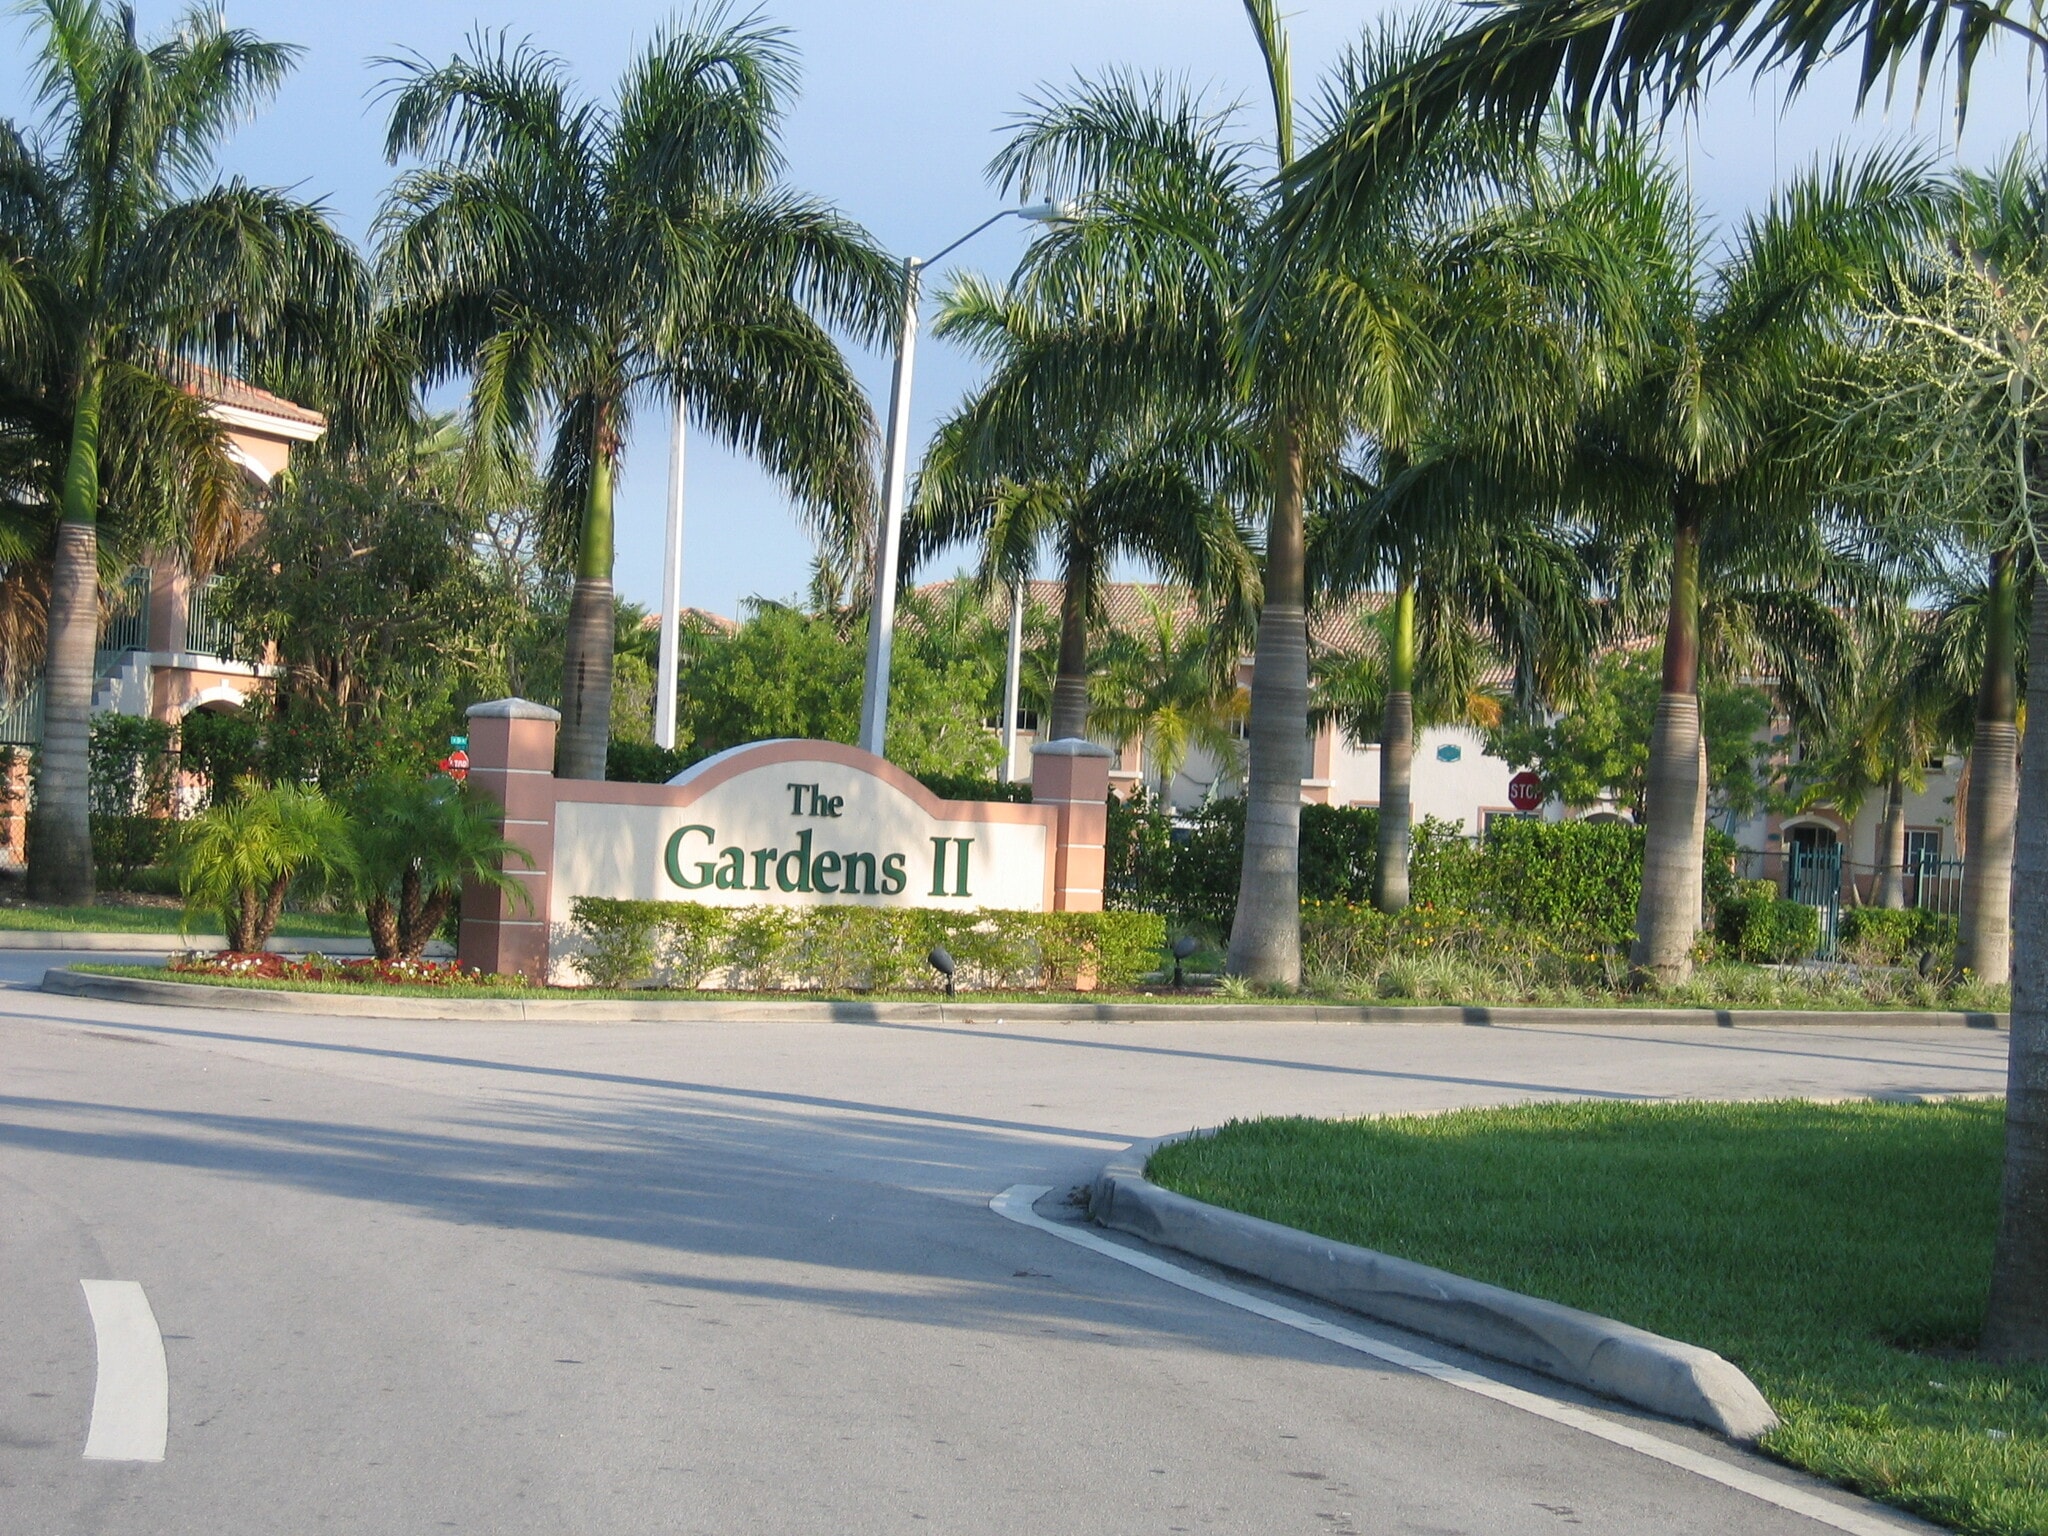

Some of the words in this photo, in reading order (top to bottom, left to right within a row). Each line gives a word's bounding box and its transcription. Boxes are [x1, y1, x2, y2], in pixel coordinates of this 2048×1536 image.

[787, 783, 844, 817] The
[664, 824, 907, 895] Gardens
[927, 836, 975, 897] II
